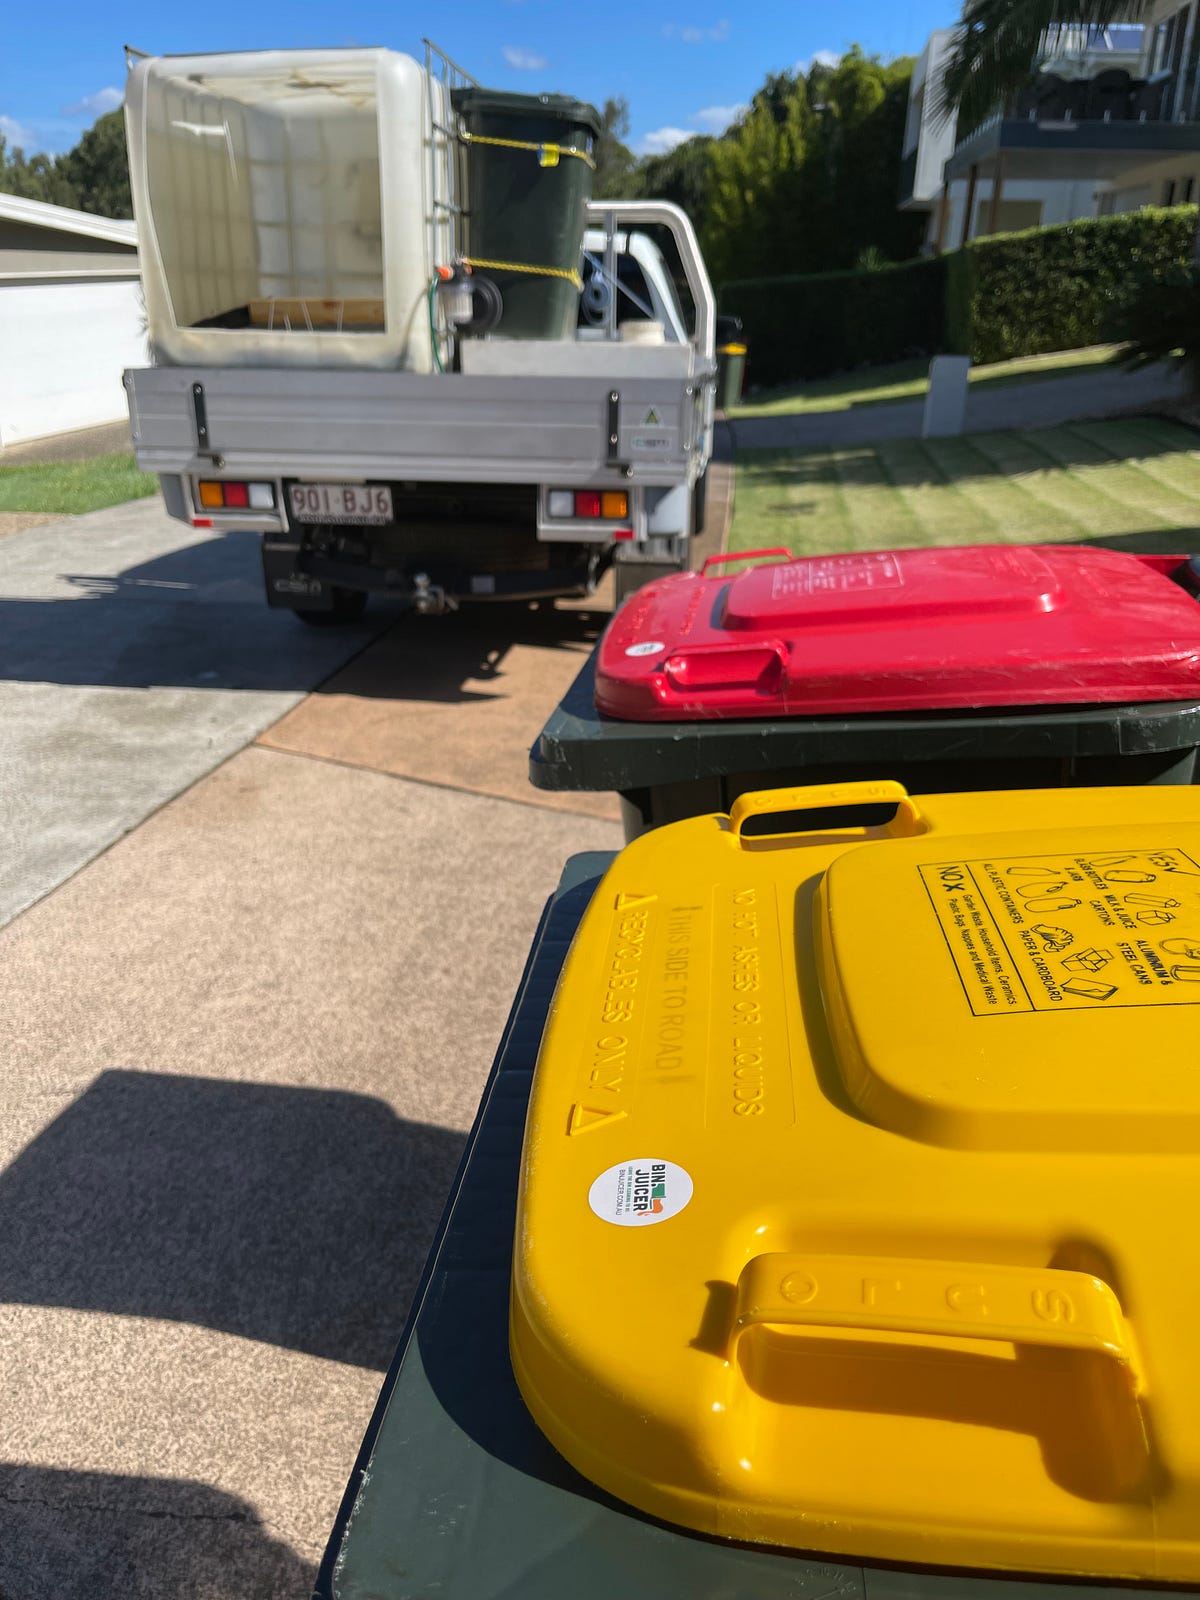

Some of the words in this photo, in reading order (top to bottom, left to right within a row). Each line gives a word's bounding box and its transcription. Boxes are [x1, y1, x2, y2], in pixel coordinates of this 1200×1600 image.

[293, 488, 330, 513] 901
[343, 488, 389, 513] BJ6
[936, 865, 964, 881] NO
[989, 871, 1006, 890] PLASTIC
[998, 887, 1024, 924] CONTAINERS
[1089, 900, 1115, 926] CARTONS
[667, 915, 692, 943] THIS
[1117, 912, 1138, 929] JUICE
[977, 927, 997, 956] Household
[602, 910, 649, 1023] RECYCLABLES
[664, 947, 689, 981] SIDE
[961, 929, 975, 950] Nappies
[974, 962, 992, 985] Medical
[984, 986, 998, 1005] Waste
[1019, 930, 1038, 950] PAPER
[1032, 957, 1063, 1002] CARDBOARD
[1116, 942, 1139, 963] STEEL
[1130, 964, 1153, 985] CANS
[663, 985, 688, 1009] TO
[733, 1002, 761, 1024] OR
[655, 1014, 685, 1070] ROAD
[588, 1035, 629, 1092] ONLY
[733, 1036, 764, 1116] LIQUIDS
[633, 1169, 650, 1212] JUICER
